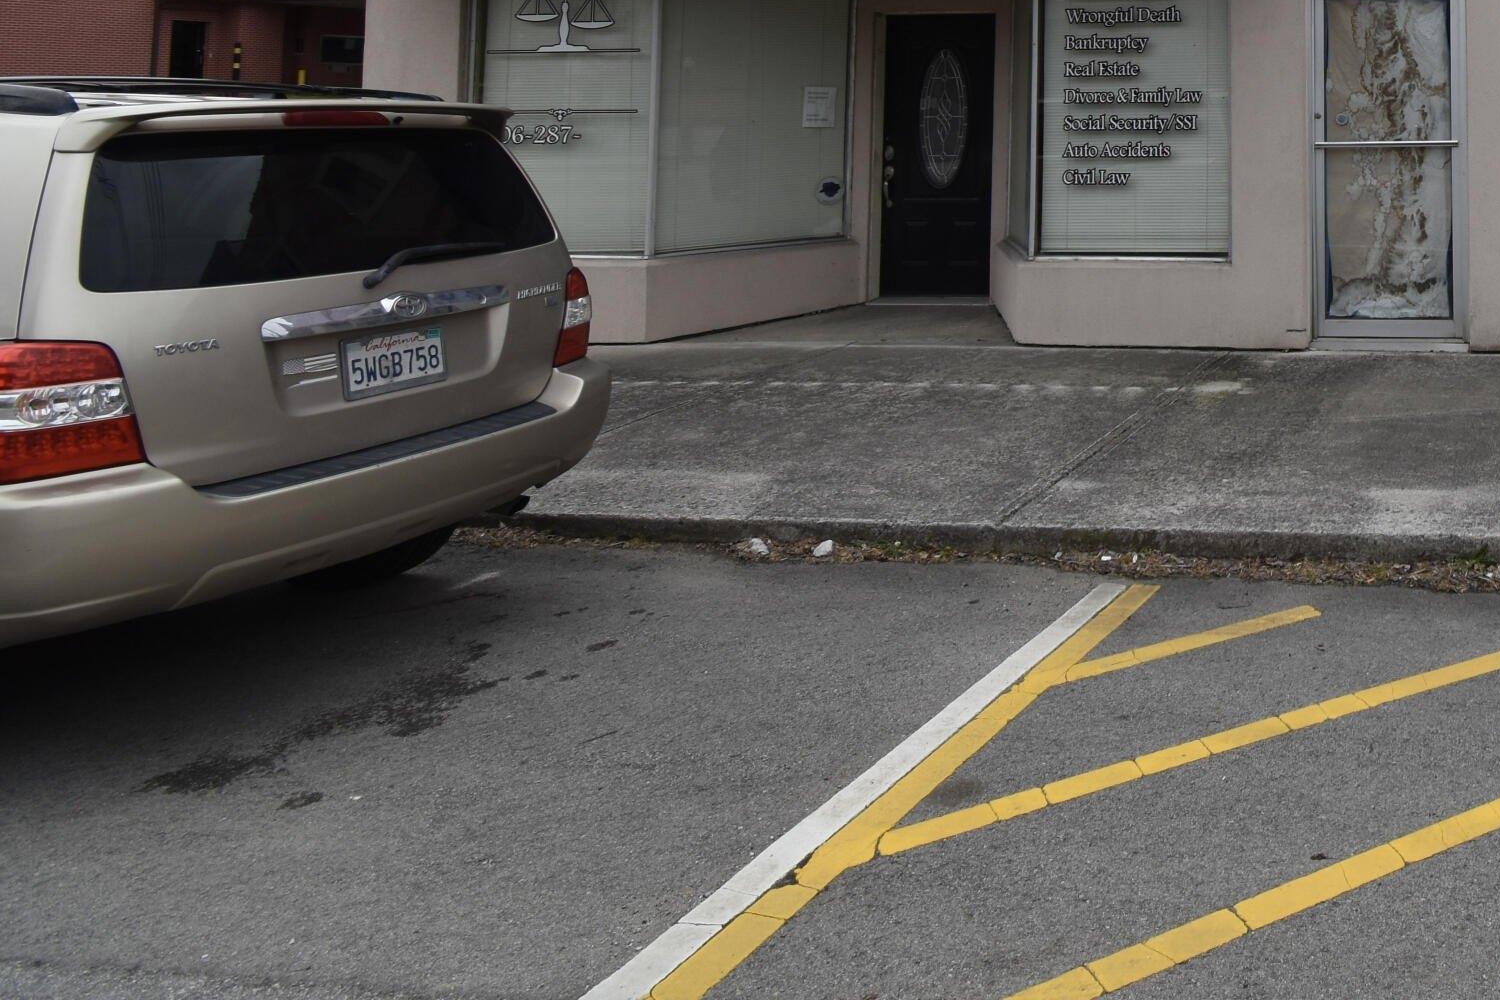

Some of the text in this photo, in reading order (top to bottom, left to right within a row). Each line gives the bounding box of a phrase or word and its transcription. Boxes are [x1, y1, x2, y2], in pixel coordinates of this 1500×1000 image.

[1066, 6, 1181, 26] Wrongful Death
[1065, 35, 1148, 52] Bankruptcy
[1064, 62, 1140, 77] Real Estate
[1064, 88, 1202, 106] Divorce & Family Law
[1063, 114, 1197, 134] Social Security/SSI
[1063, 142, 1171, 158] Auto Accidents
[1062, 169, 1130, 185] Civil Law
[154, 338, 220, 356] TOYOTA
[351, 344, 440, 385] 5WGB758
